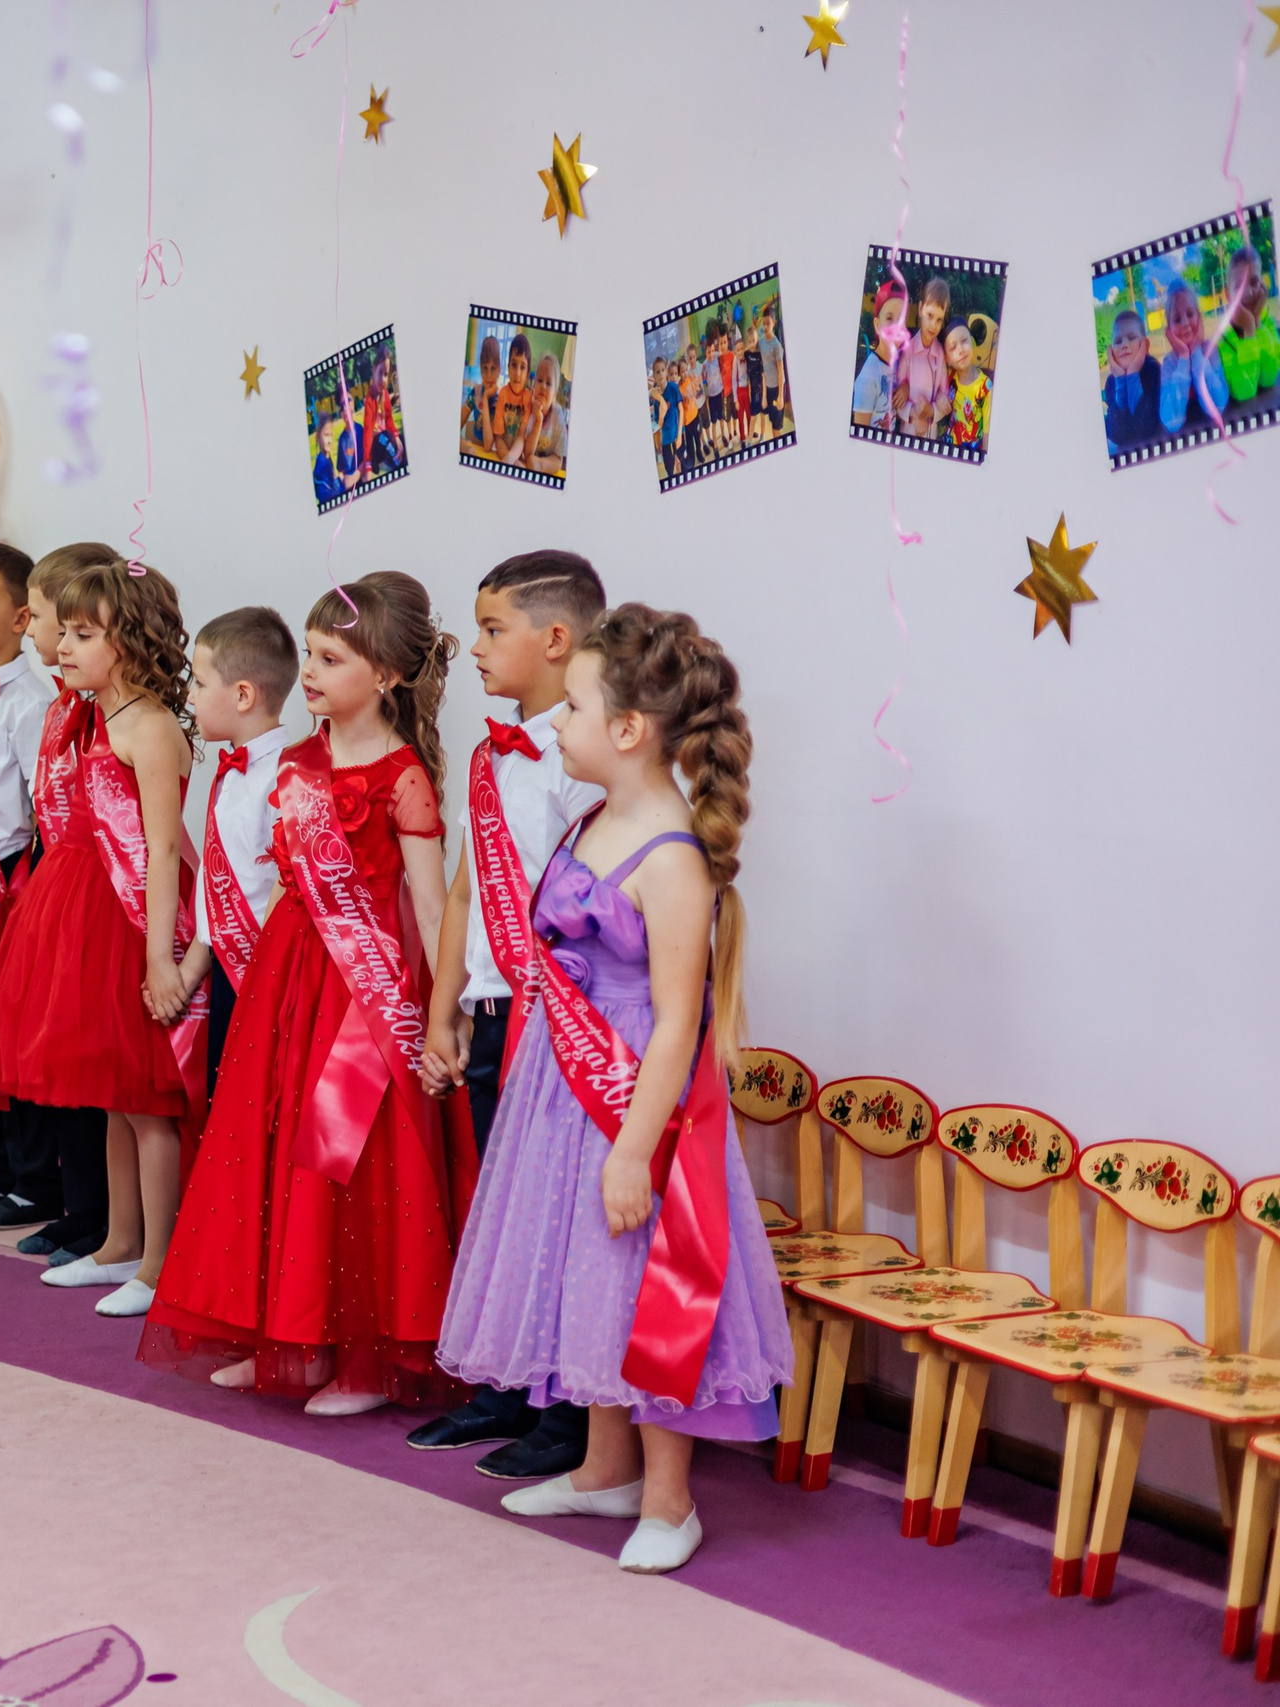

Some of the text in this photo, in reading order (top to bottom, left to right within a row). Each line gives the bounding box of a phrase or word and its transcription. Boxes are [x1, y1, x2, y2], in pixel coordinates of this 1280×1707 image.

[40, 802, 53, 831] сада
[122, 882, 140, 912] сада
[208, 844, 254, 962] Выпуск
[476, 780, 528, 958] Выпускник
[480, 868, 491, 904] сада
[212, 921, 227, 950] сада
[292, 854, 371, 991] детского сада №4
[311, 829, 402, 1006] Выпускница
[353, 884, 402, 977] Горобенко Анна
